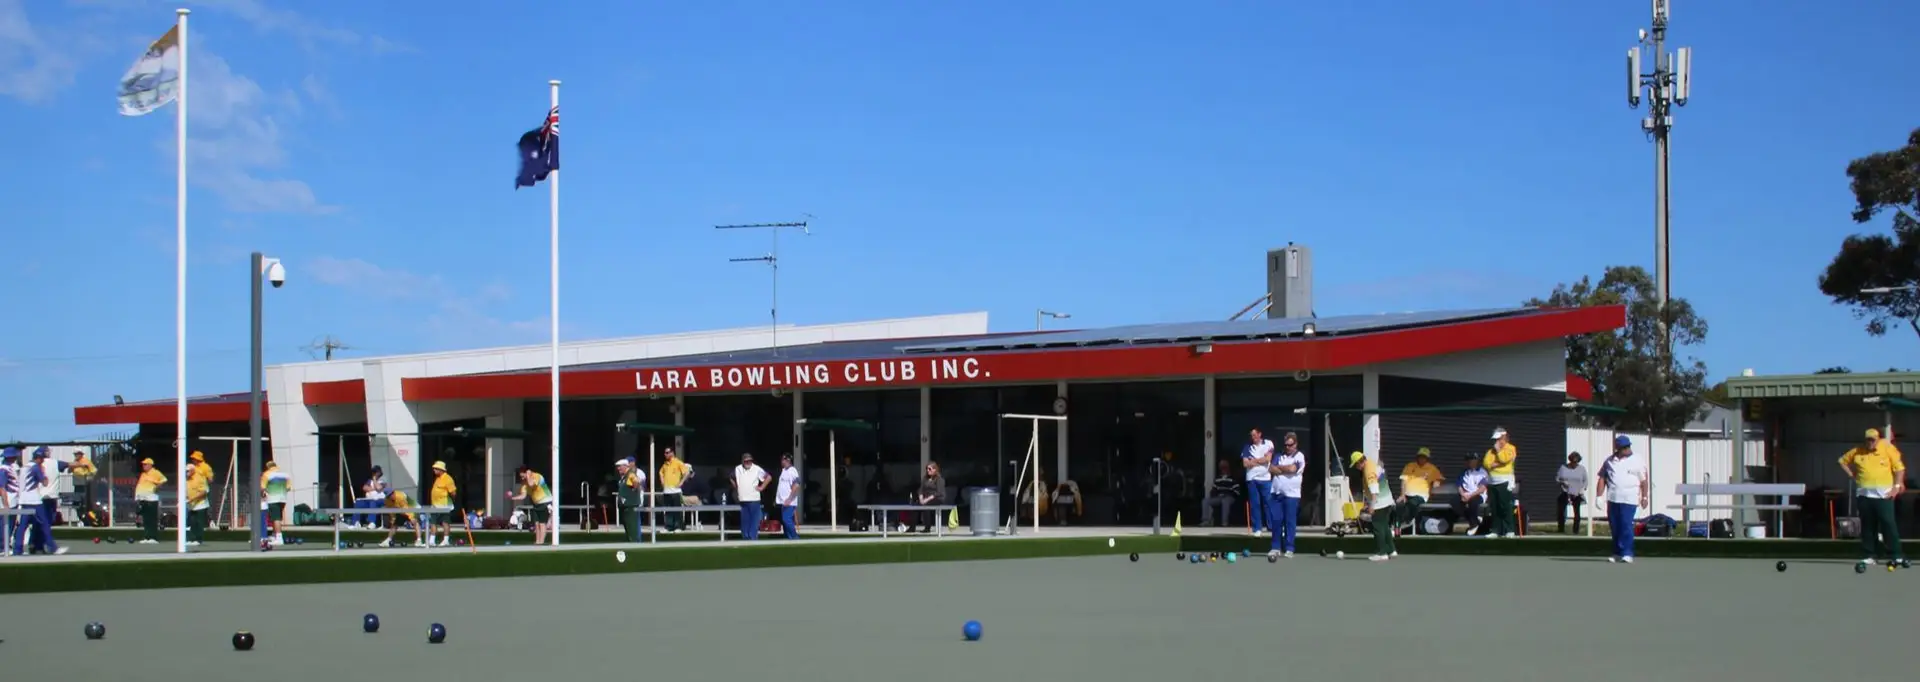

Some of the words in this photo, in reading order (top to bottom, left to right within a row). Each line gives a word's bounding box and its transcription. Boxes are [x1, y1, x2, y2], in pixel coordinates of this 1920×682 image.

[635, 369, 698, 390] LARA
[710, 363, 830, 387] BOWLING
[844, 360, 916, 383] CLUB
[931, 357, 991, 380] INC.
